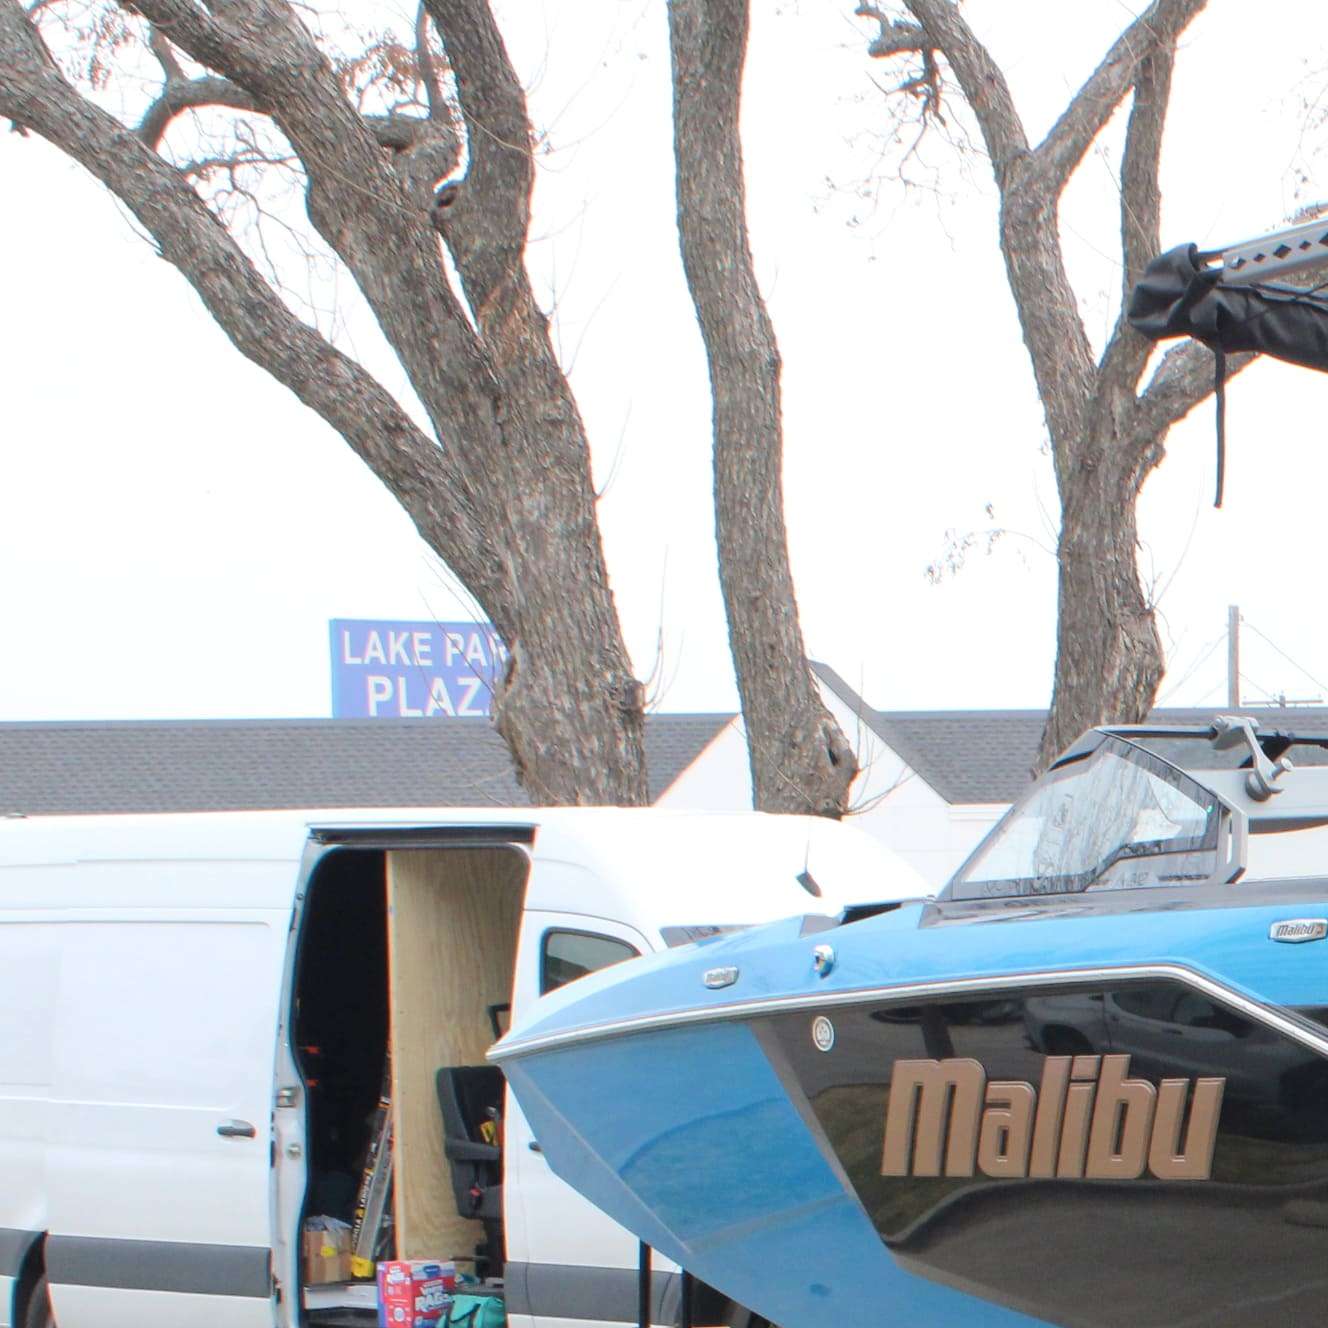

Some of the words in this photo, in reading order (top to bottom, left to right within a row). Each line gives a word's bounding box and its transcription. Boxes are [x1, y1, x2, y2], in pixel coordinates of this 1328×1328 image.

[343, 631, 432, 666] LAKE
[367, 676, 491, 717] PLAZ
[881, 1054, 1227, 1181] Malibu
